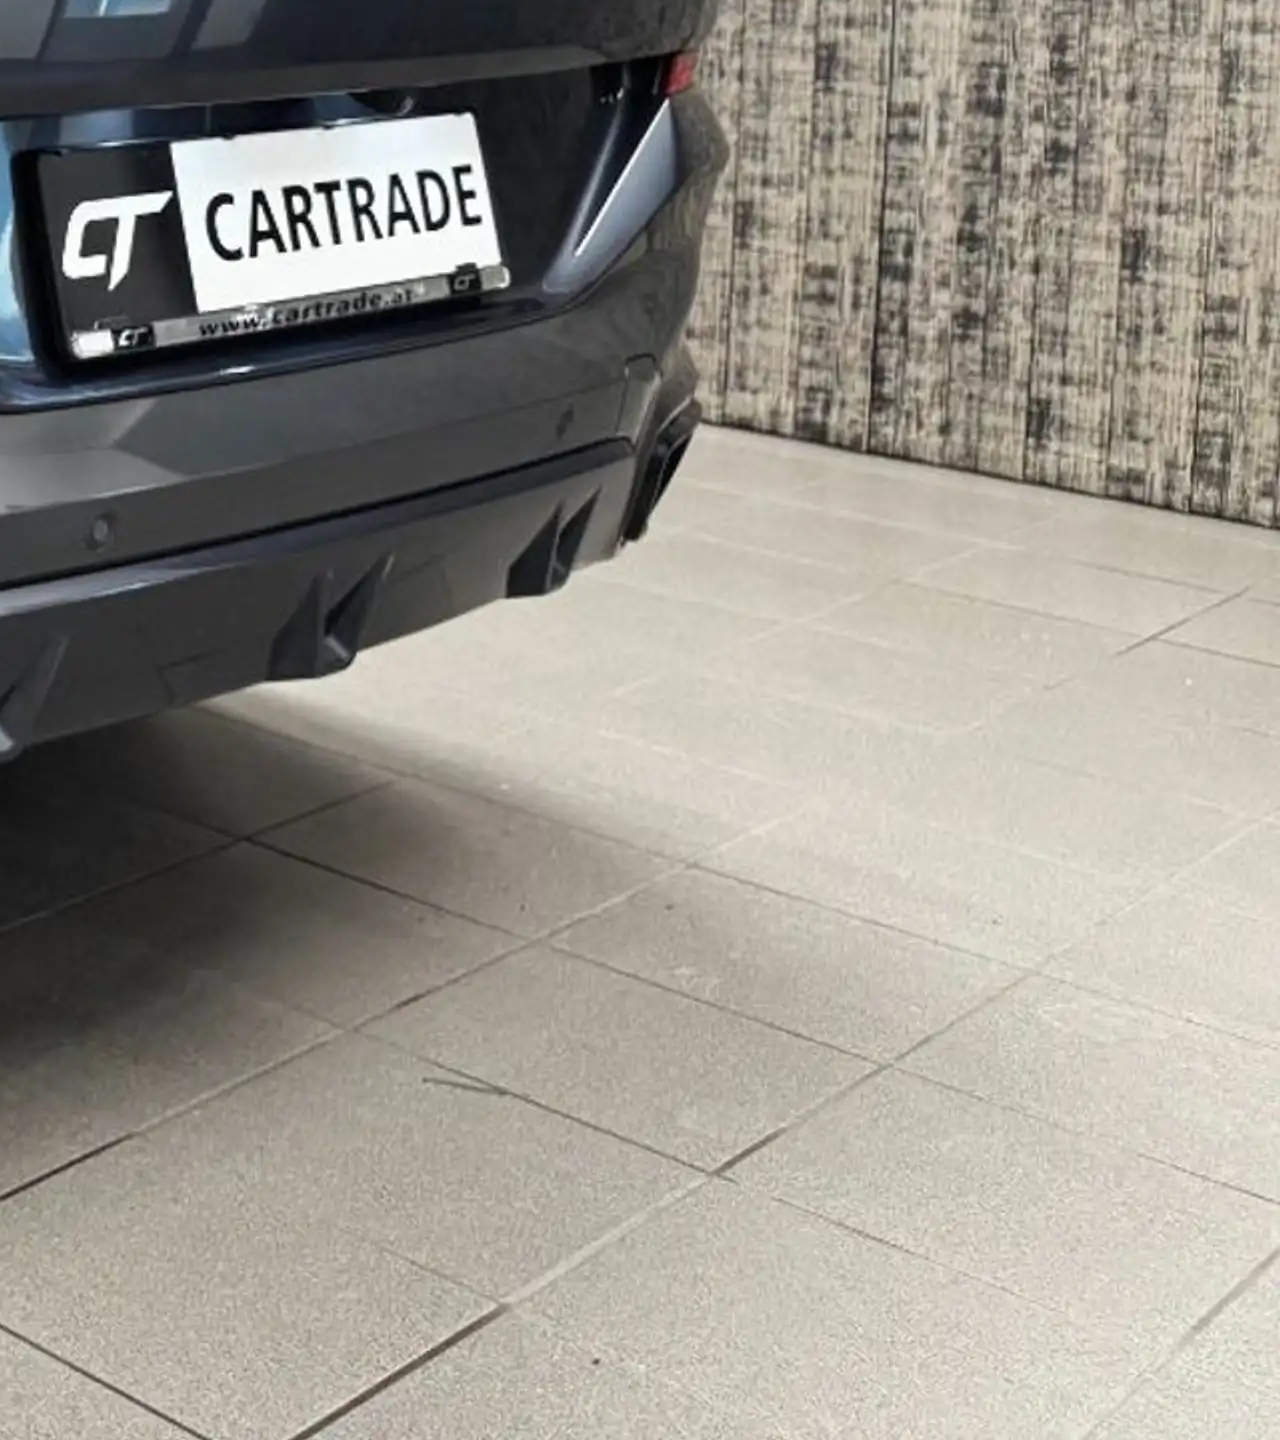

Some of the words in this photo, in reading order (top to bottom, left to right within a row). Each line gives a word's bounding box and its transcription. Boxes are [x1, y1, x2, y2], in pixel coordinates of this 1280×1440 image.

[62, 188, 174, 292] CT
[204, 162, 484, 262] CARTRADE
[197, 287, 416, 337] www.cartrade.at
